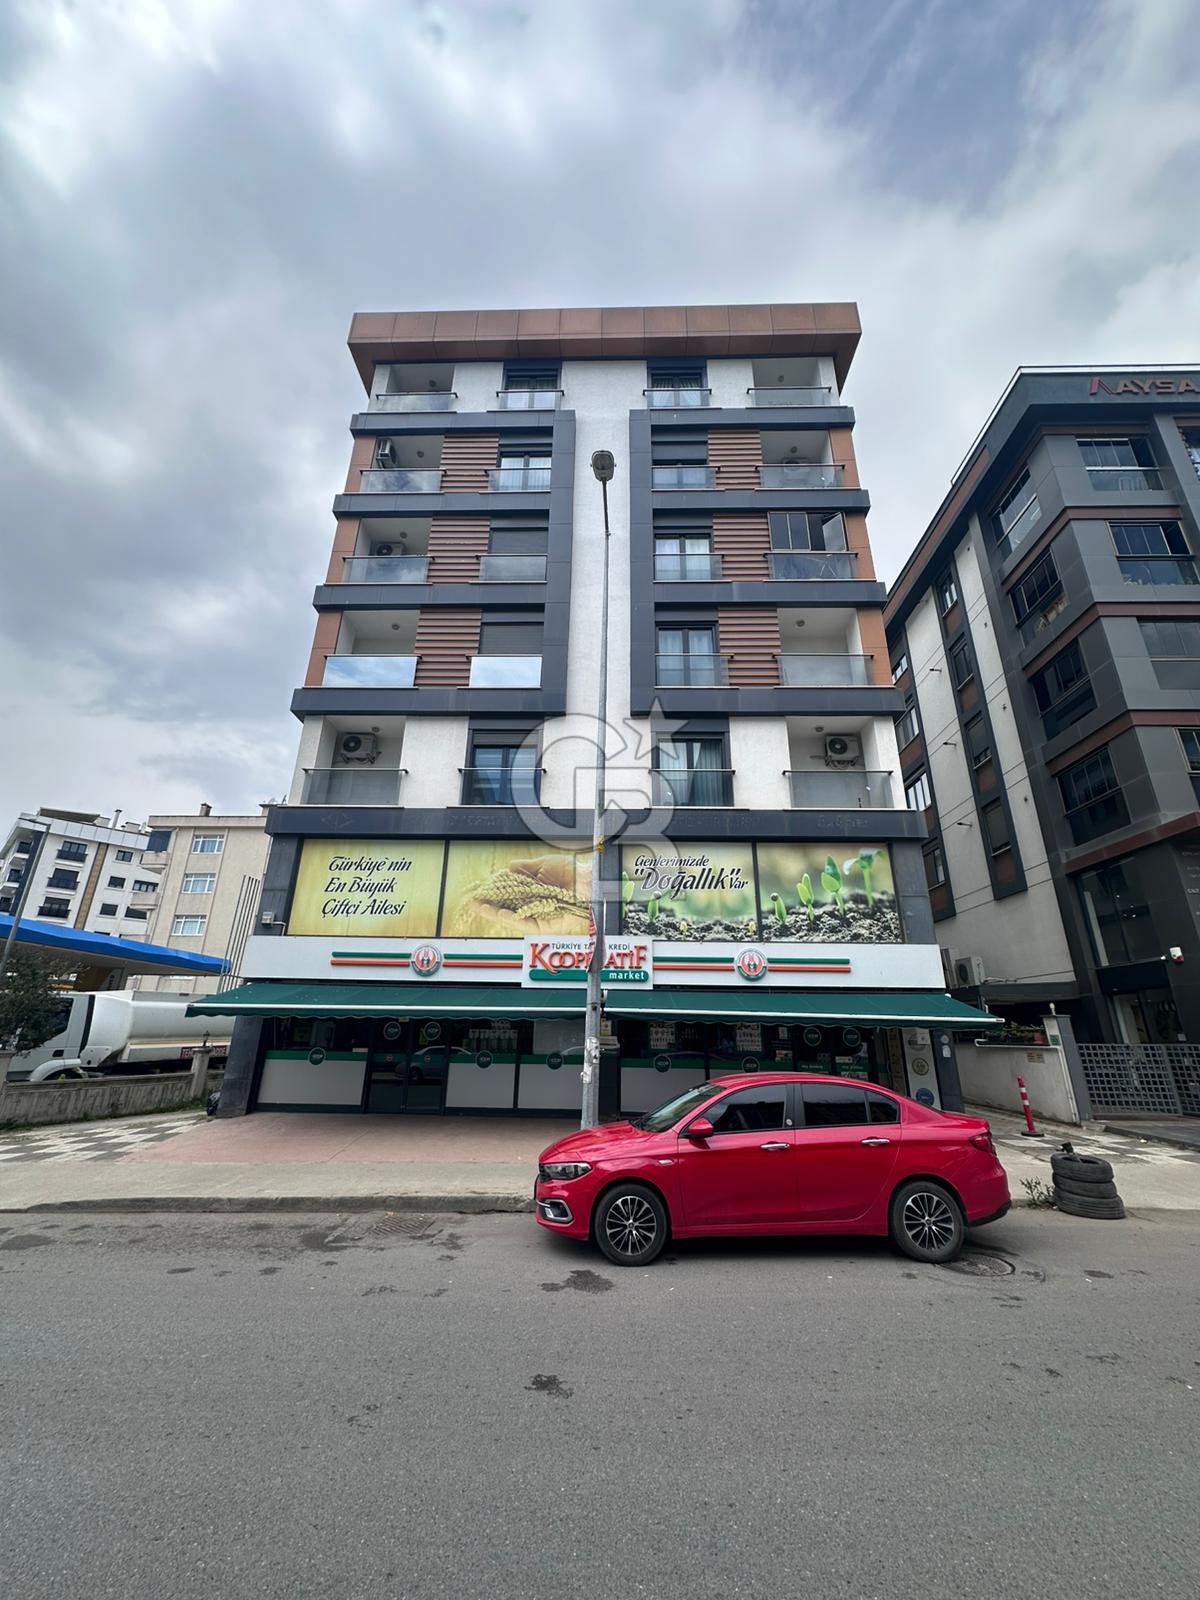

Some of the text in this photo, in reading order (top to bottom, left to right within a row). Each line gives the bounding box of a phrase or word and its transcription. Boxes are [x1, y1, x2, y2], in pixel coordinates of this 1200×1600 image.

[634, 855, 710, 867] Genlerimizde
[324, 876, 398, 899] En Büyük
[729, 877, 749, 889] Var
[321, 898, 407, 918] Çiftçi Ailesi
[551, 942, 581, 950] TÜRKİYE
[608, 943, 630, 951] KREDİ
[609, 971, 645, 980] market
